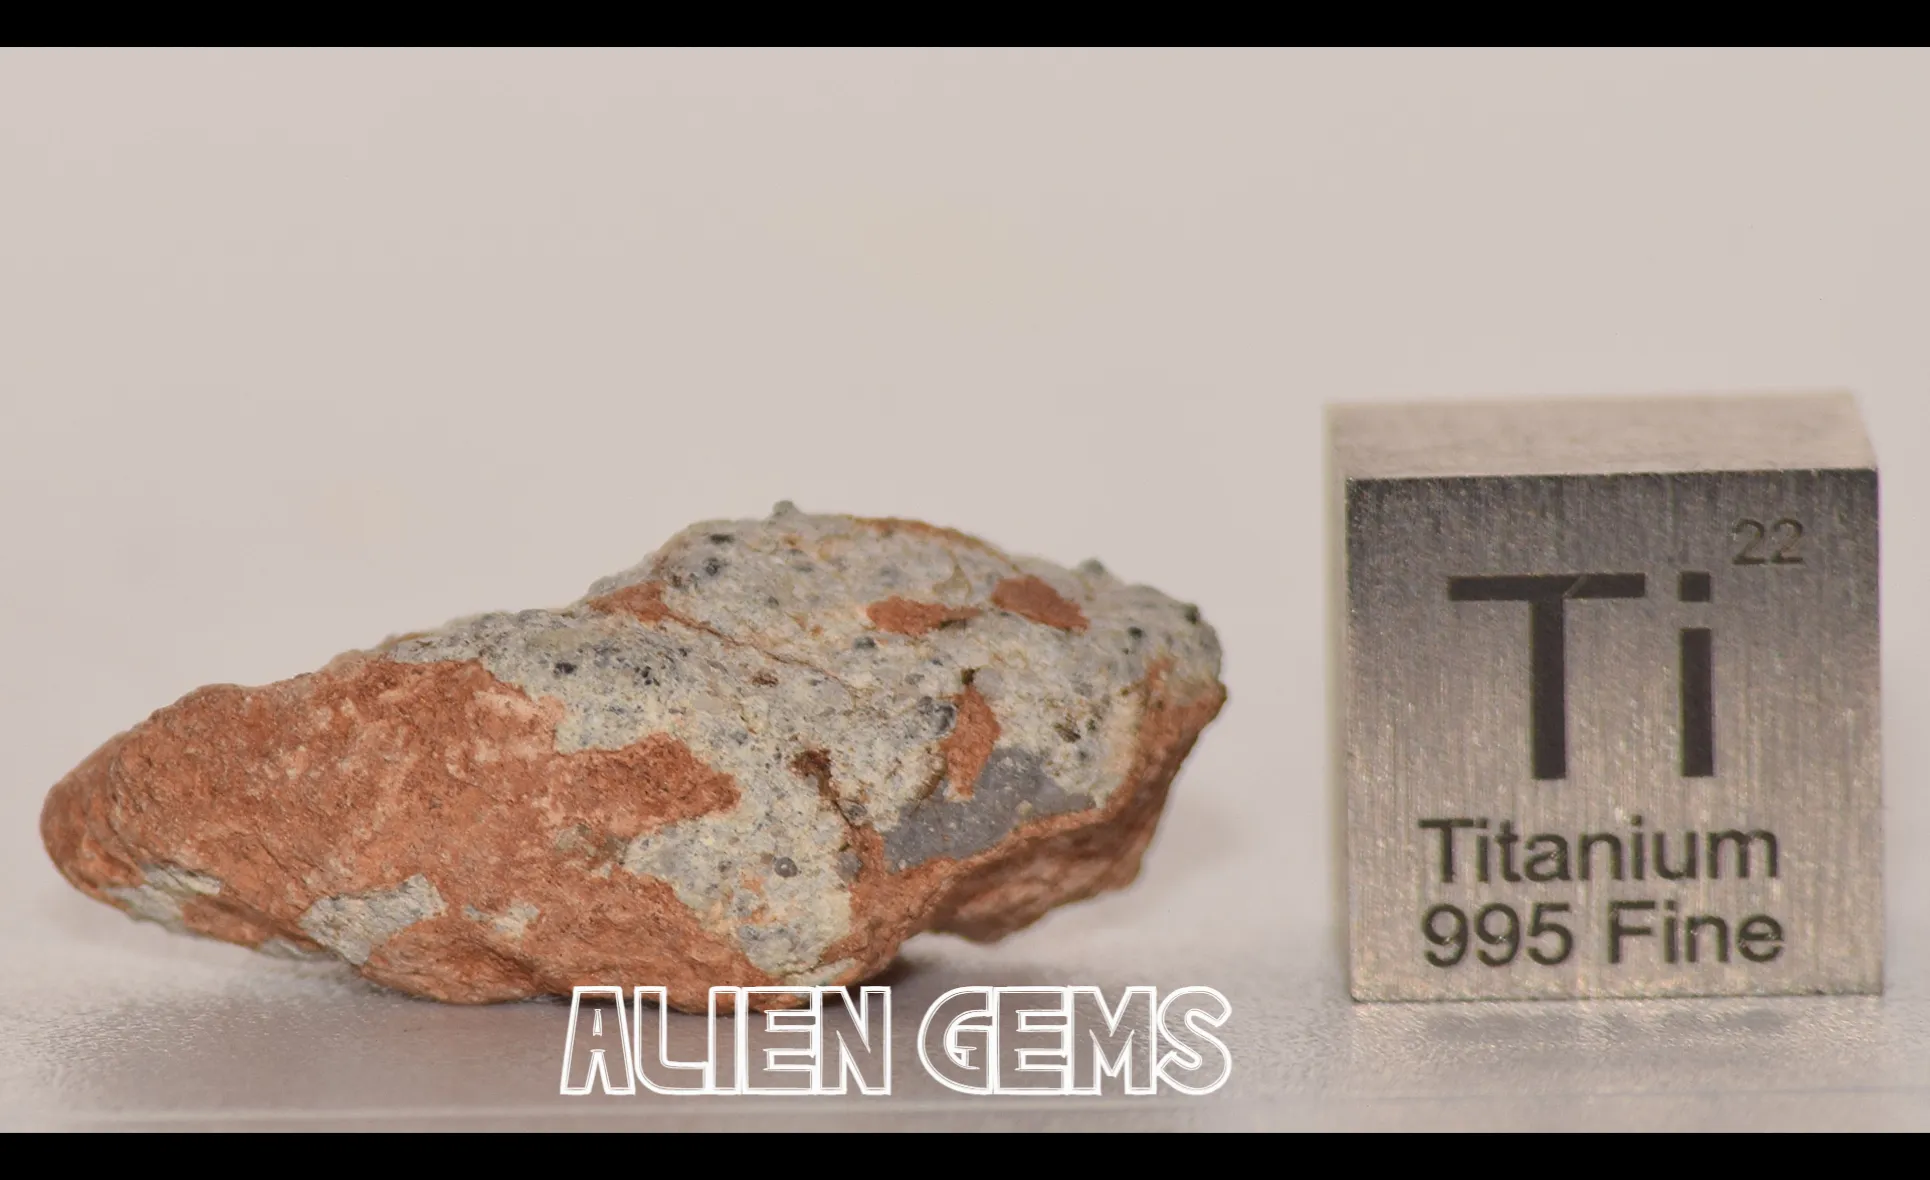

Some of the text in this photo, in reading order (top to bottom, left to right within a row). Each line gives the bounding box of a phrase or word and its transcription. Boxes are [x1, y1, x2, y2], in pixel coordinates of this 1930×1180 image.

[1731, 518, 1806, 566] 22
[1446, 570, 1715, 781] Ti
[1417, 814, 1780, 884] Titanium
[1420, 899, 1786, 968] 995 Fine
